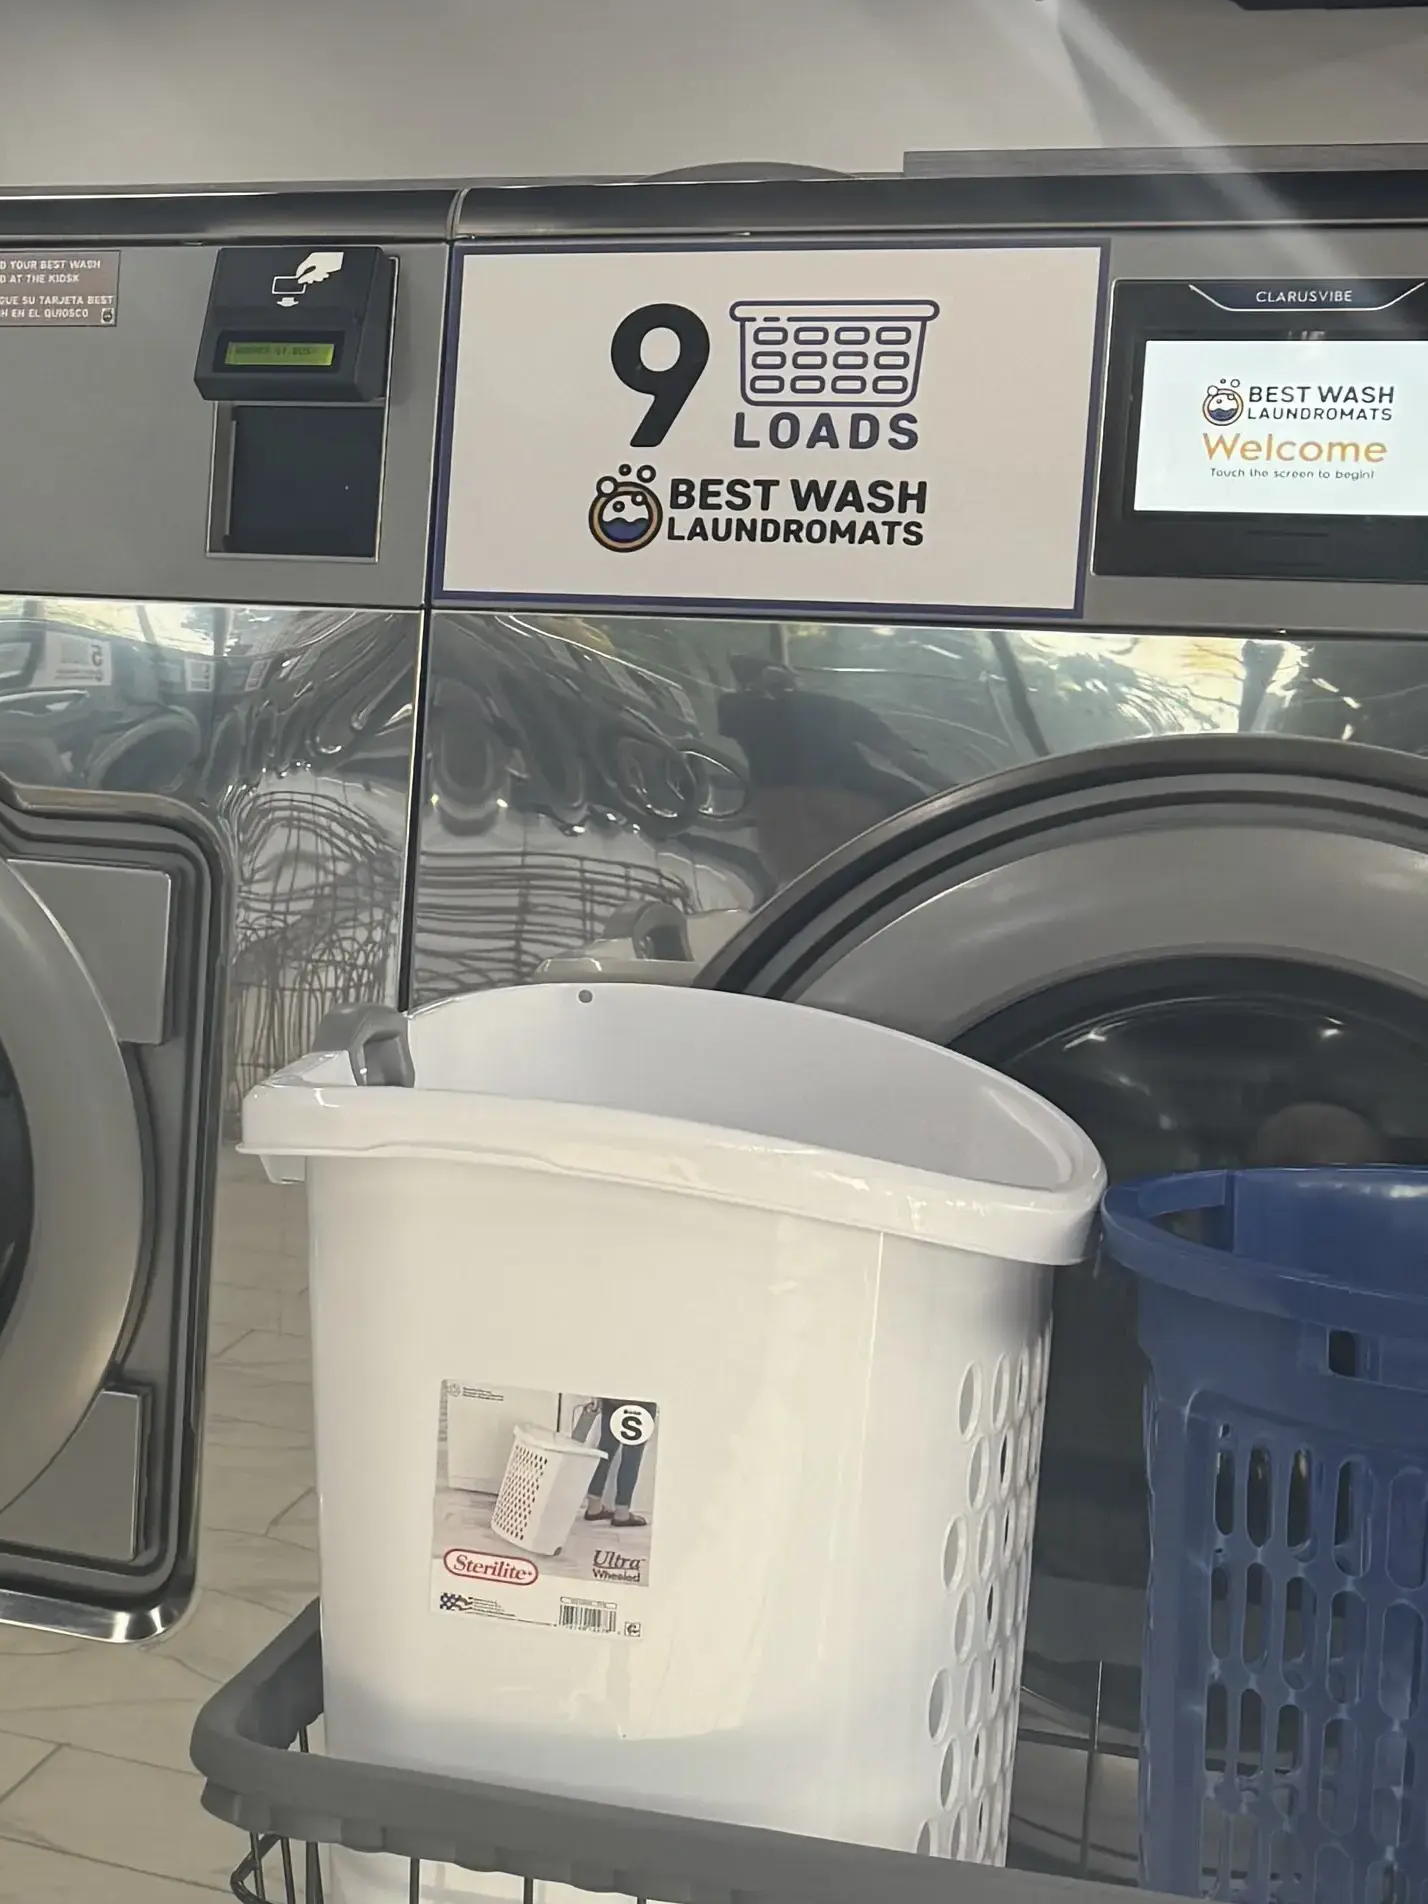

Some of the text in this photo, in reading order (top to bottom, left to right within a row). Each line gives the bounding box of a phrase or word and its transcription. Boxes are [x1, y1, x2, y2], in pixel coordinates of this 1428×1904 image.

[10, 260, 37, 270] YOUR
[40, 260, 65, 270] BEST
[69, 260, 101, 269] WASH
[9, 274, 22, 283] AT
[26, 274, 45, 283] THE
[48, 274, 80, 283] KIOSK
[22, 296, 36, 305] SU
[40, 296, 84, 305] TARJETA
[87, 296, 114, 305] BEST
[1255, 289, 1354, 303] CLARUSVIBE
[28, 309, 40, 318] EL
[44, 308, 89, 318] QUIOSCO
[610, 303, 710, 447] 9
[1249, 386, 1396, 404] BEST WASH
[1248, 407, 1394, 421] LAUNDROMATS
[733, 412, 919, 450] LOADS
[1202, 432, 1388, 463] Welcome
[1210, 467, 1245, 478] Touch
[1250, 467, 1269, 478] the
[1274, 470, 1314, 479] screen
[1318, 468, 1331, 479] to
[669, 478, 928, 514] BEST WASH
[667, 517, 925, 546] LAUNDROMATS
[620, 1416, 642, 1441] S
[453, 1554, 527, 1582] Sterilite
[593, 1550, 641, 1569] Ultra
